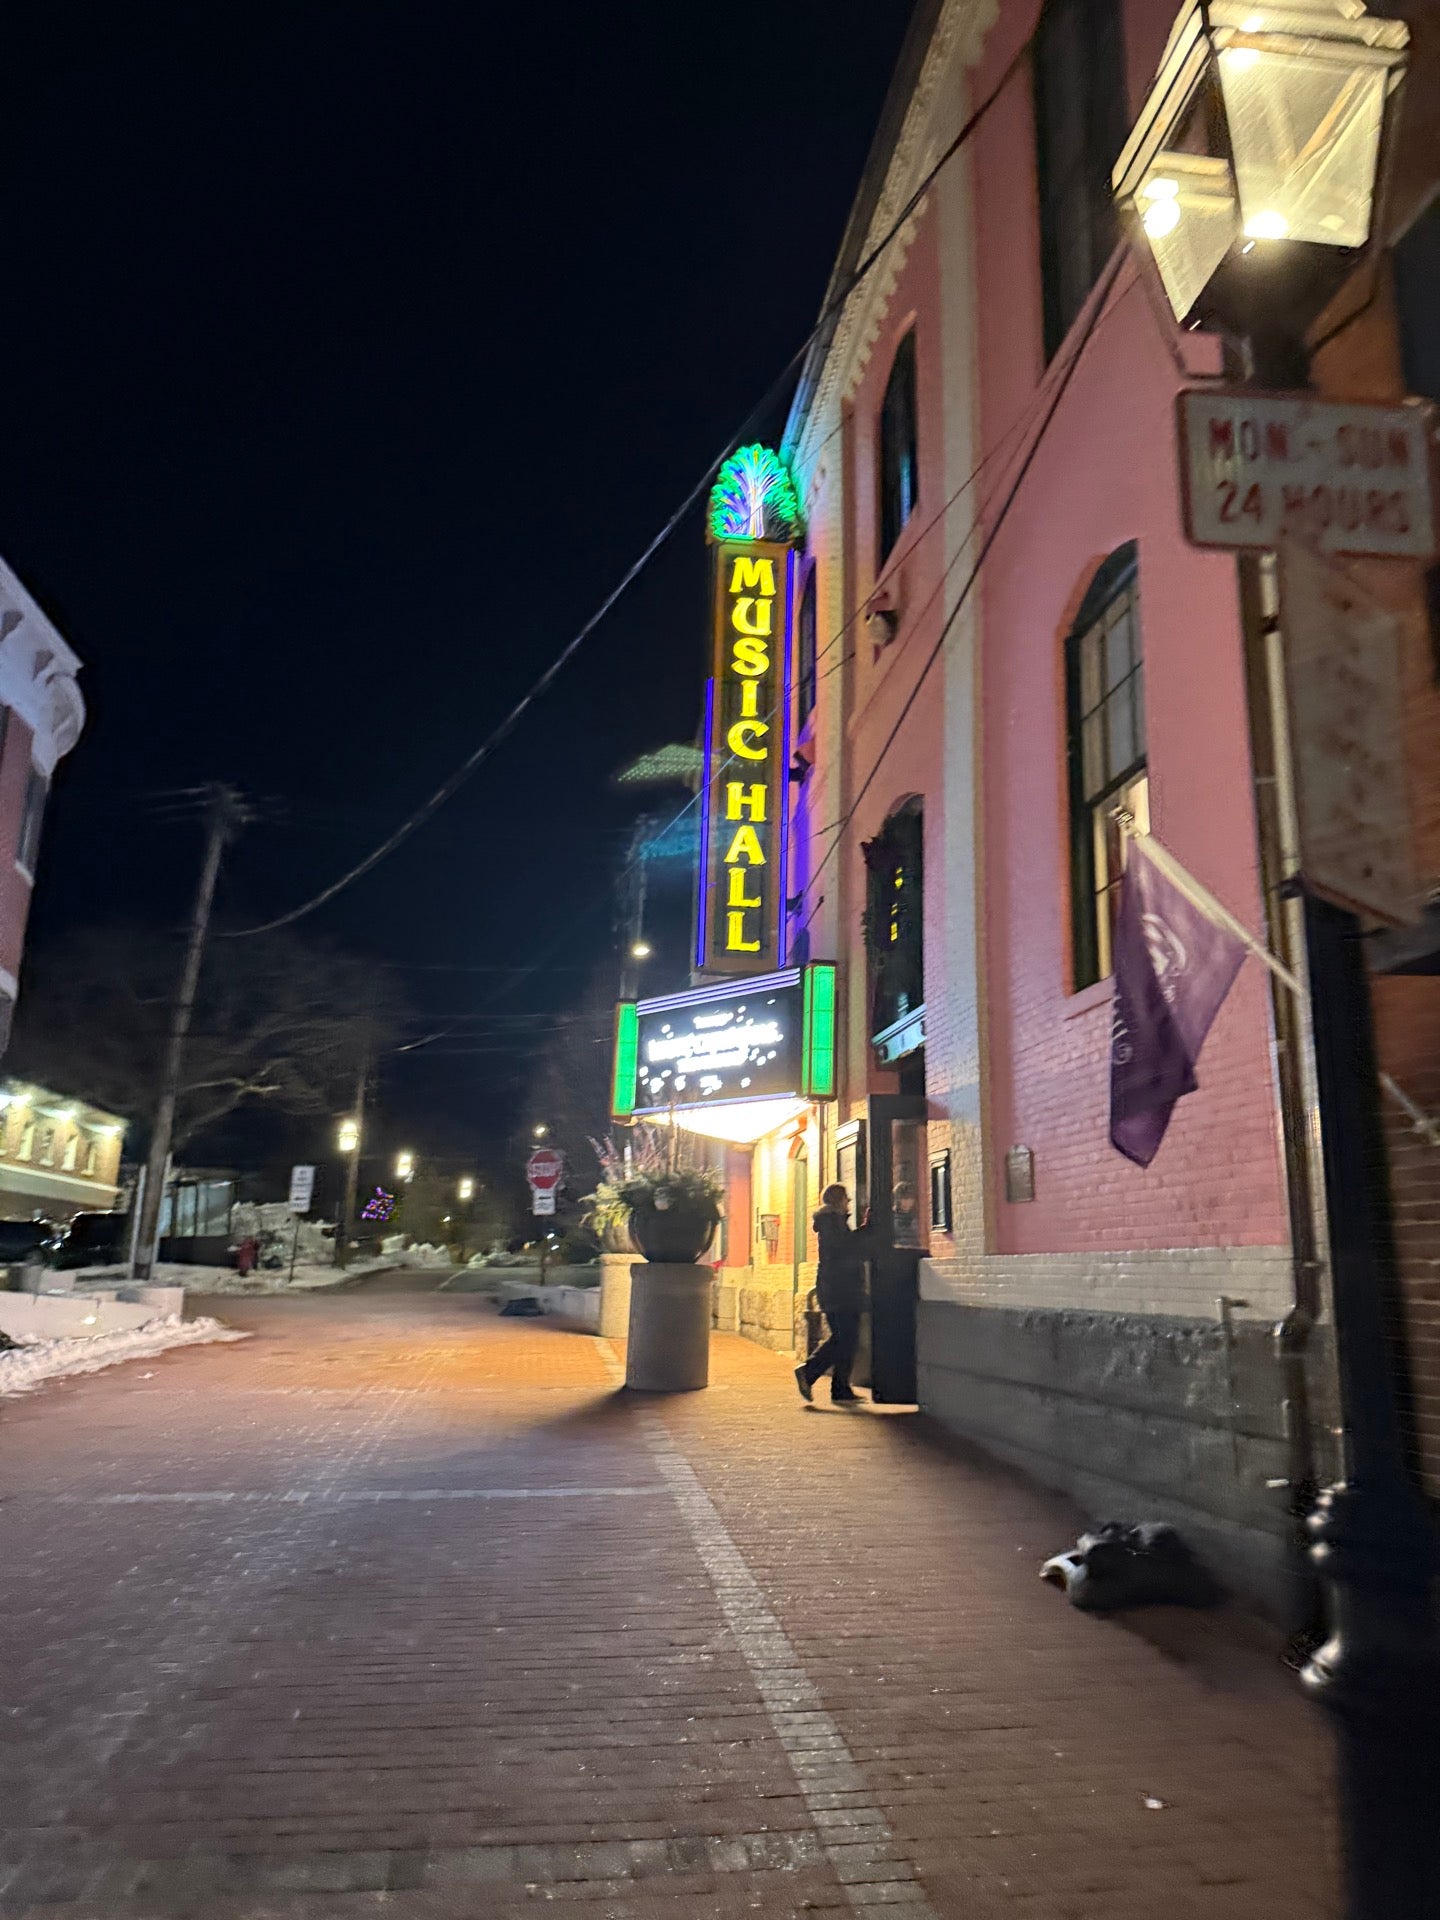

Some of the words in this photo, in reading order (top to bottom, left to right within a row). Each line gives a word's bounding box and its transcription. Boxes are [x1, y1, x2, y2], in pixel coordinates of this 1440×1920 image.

[1208, 416, 1290, 462] MON
[1216, 478, 1264, 524] 24
[1280, 483, 1411, 534] HOURS
[727, 556, 776, 760] MUSIC
[724, 781, 768, 952] HALL
